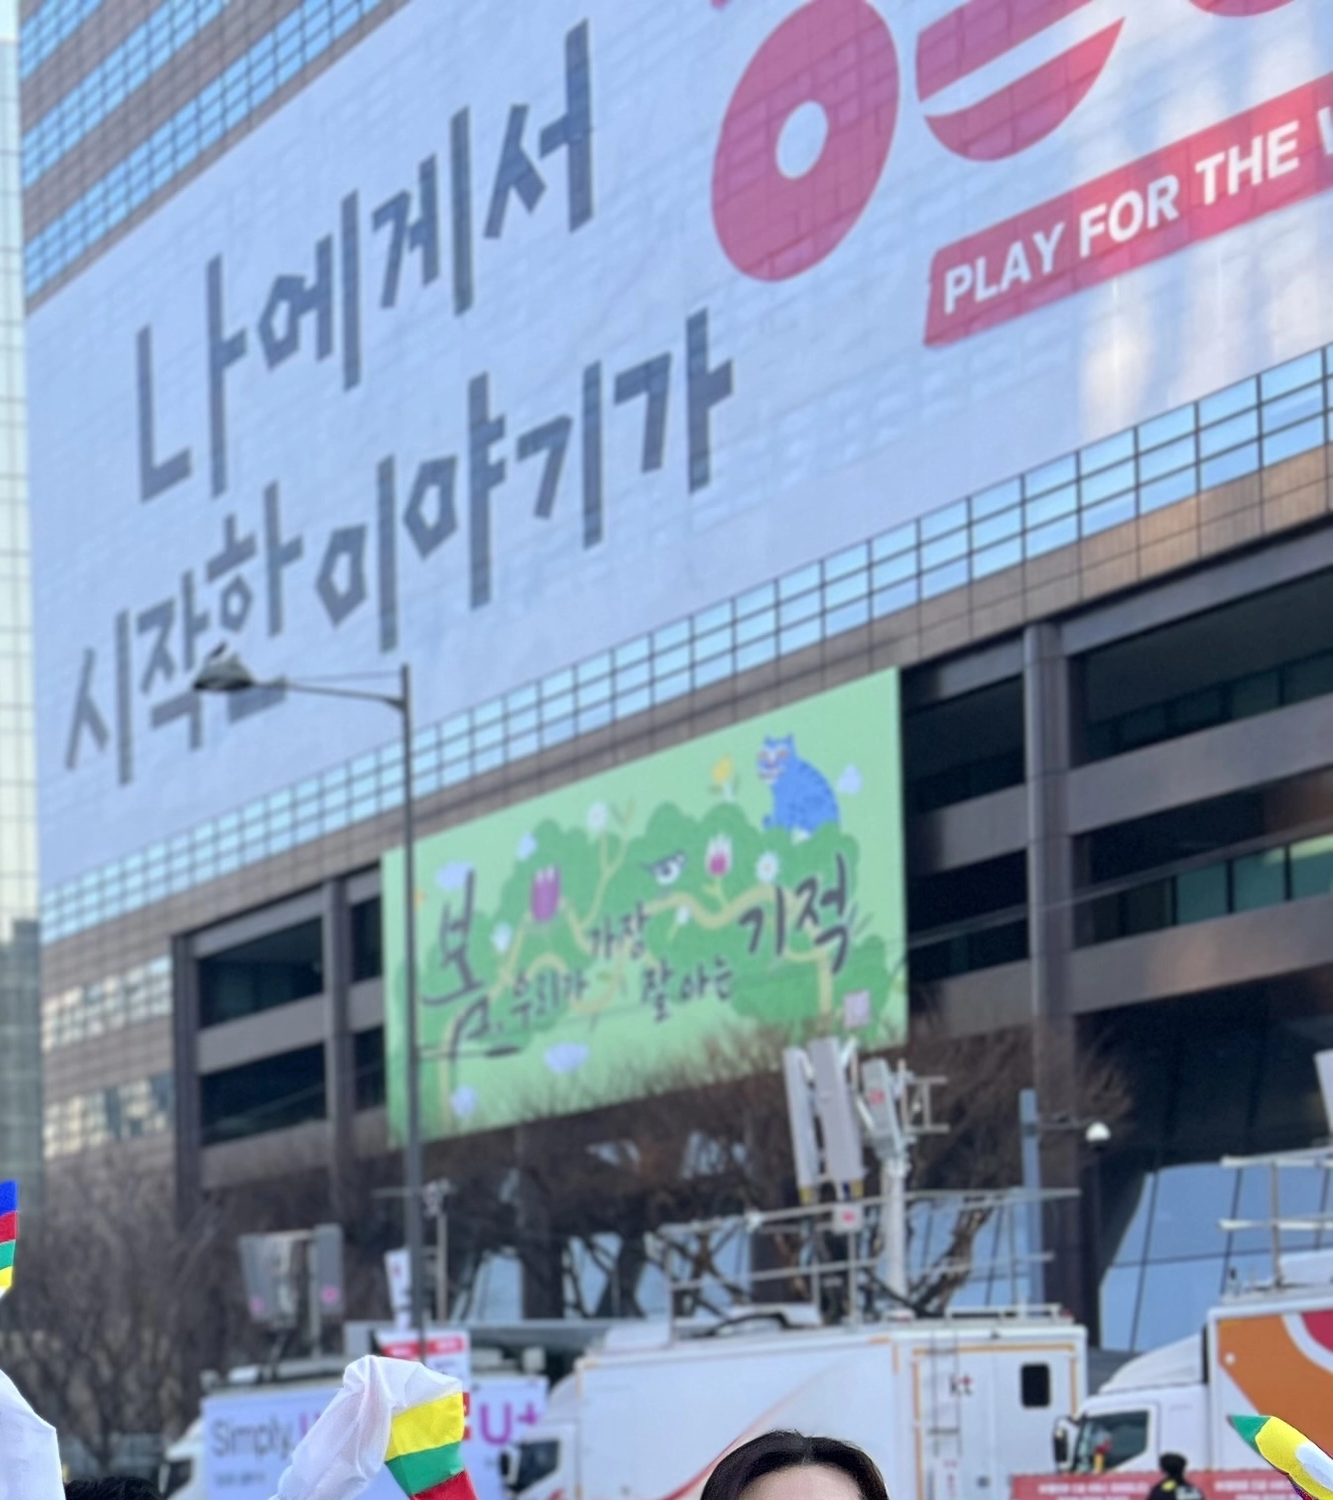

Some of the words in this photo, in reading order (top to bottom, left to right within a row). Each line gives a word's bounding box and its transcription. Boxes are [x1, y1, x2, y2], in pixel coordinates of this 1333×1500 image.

[136, 17, 594, 501] 나에게서
[942, 221, 1066, 315] PLAY
[1077, 174, 1181, 258] FOR
[1195, 119, 1301, 206] THE
[738, 854, 852, 975] 기적
